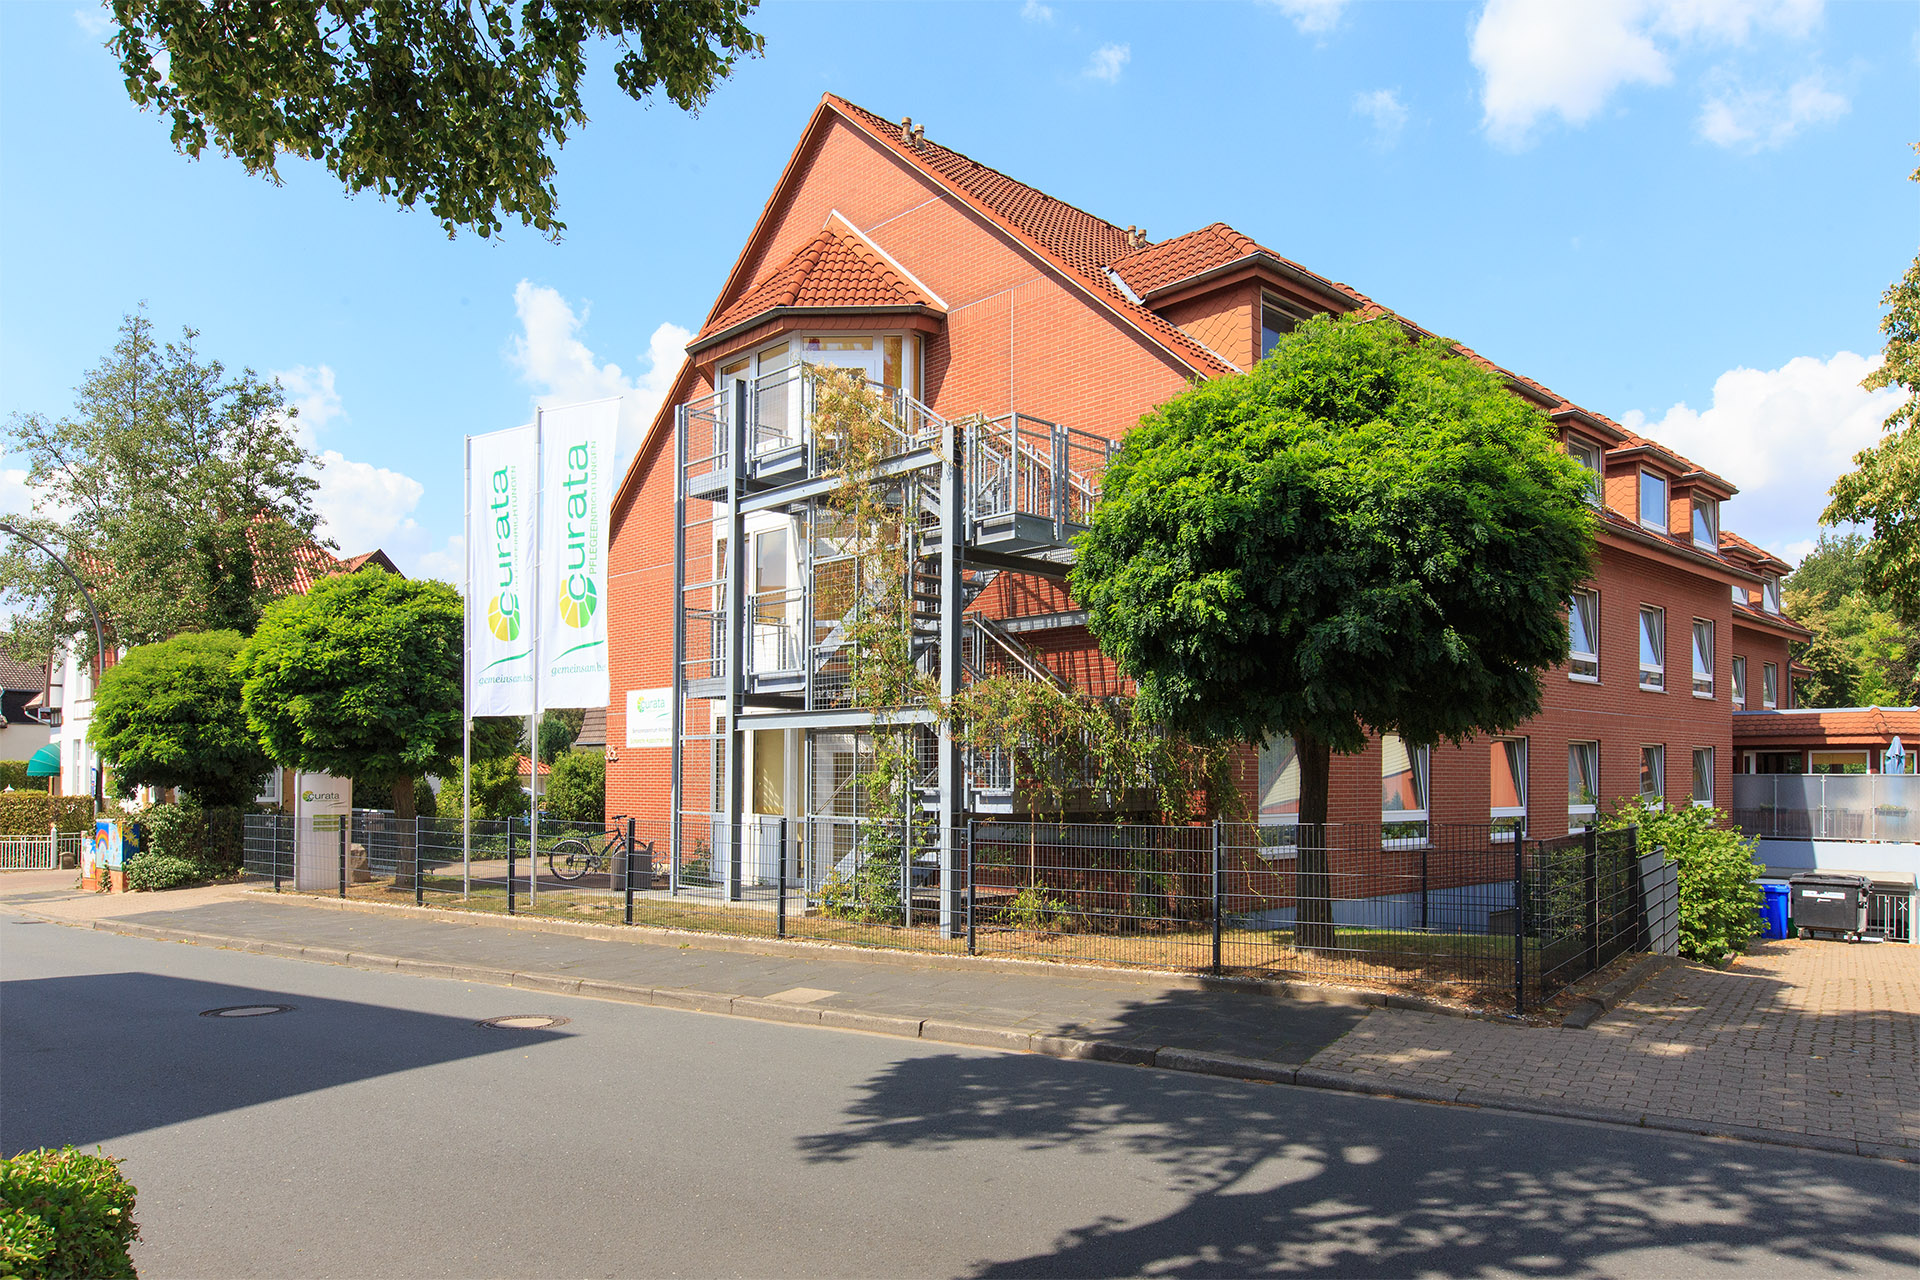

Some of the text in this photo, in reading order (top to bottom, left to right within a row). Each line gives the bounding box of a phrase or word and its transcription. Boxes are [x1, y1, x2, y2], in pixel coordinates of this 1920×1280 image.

[490, 465, 514, 616] curata
[562, 440, 589, 601] curata
[641, 698, 665, 710] curata
